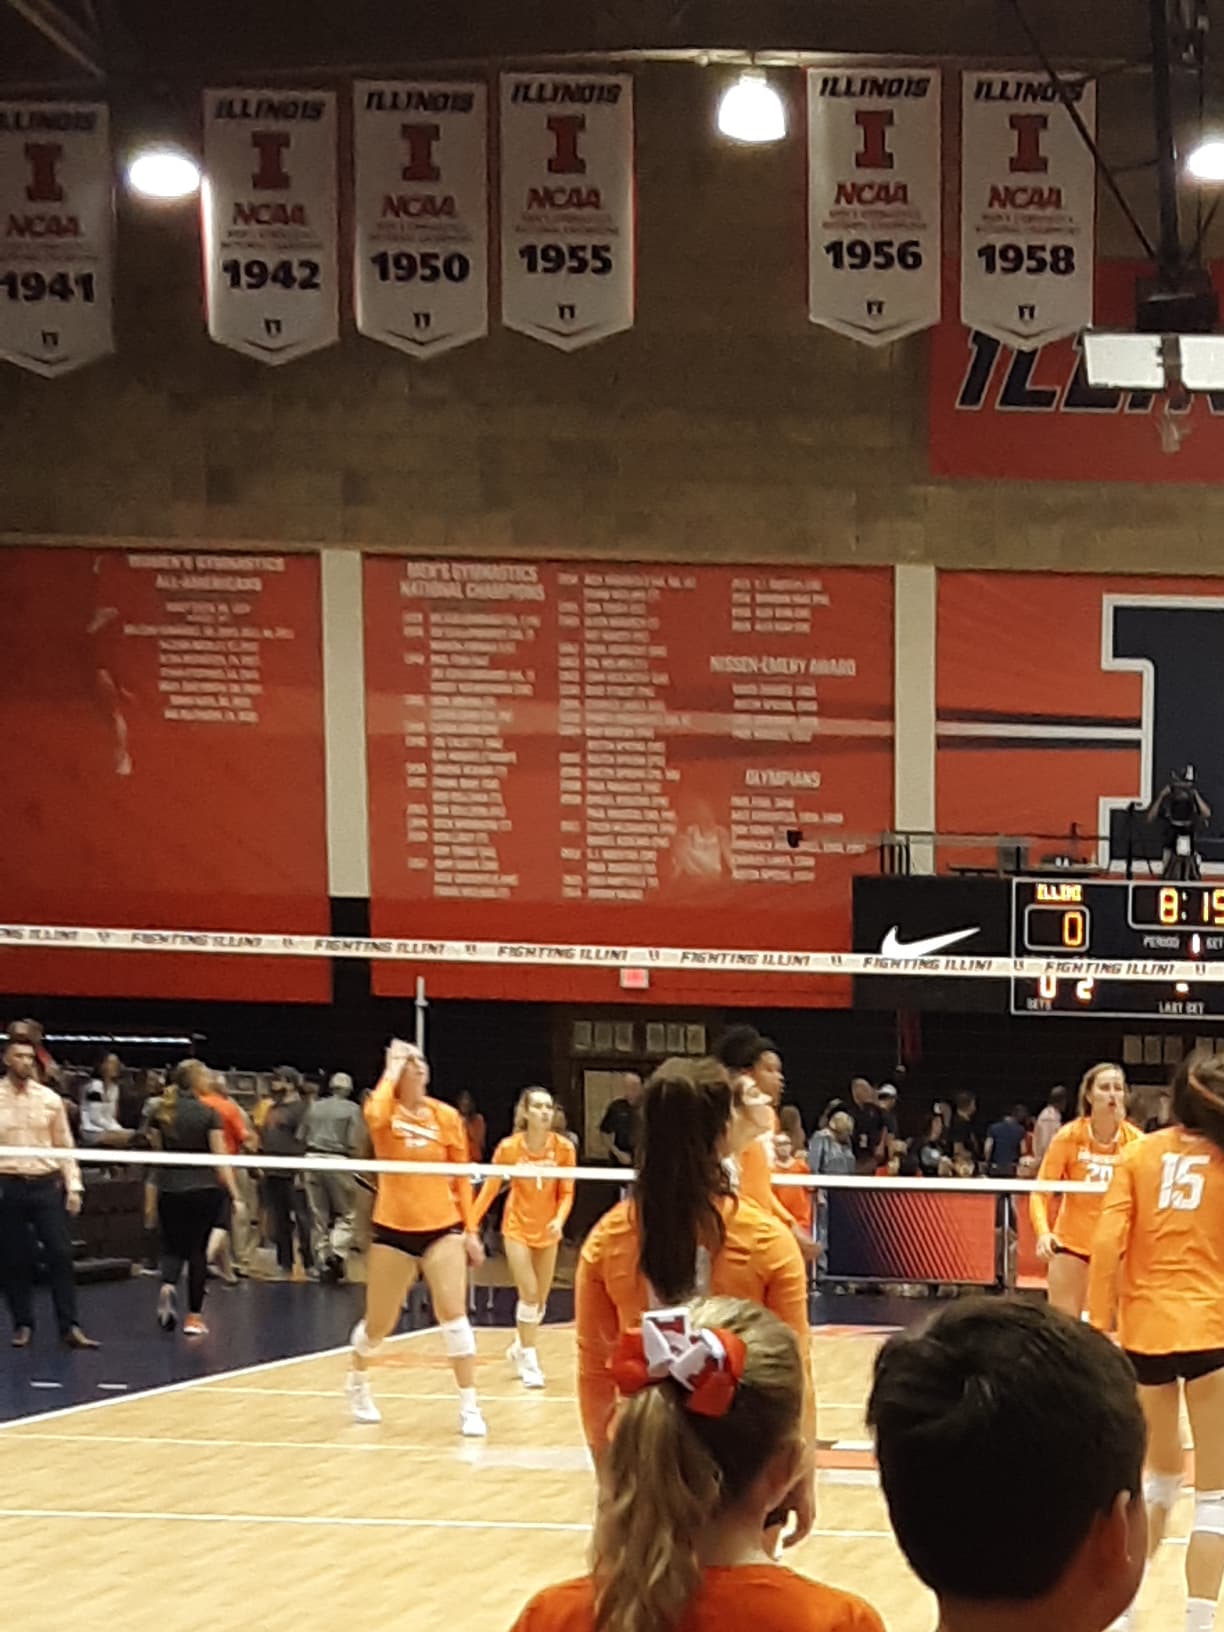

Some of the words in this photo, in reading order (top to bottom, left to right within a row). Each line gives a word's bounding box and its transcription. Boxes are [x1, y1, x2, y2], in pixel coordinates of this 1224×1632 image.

[511, 82, 622, 105] ILLINOIS
[819, 76, 931, 98] ILLINOIS
[214, 99, 325, 121] ILLINOIS
[366, 90, 475, 113] ILLINOIS
[0, 112, 96, 131] LLINOIS
[527, 186, 602, 210] NCAA
[834, 182, 909, 205] NCAA
[988, 185, 1062, 209] NCAA
[233, 204, 305, 226] NCAA
[382, 195, 455, 217] NCAA
[6, 215, 80, 237] NCAA
[519, 244, 613, 275] 1955
[823, 240, 923, 270] 1956
[977, 244, 1075, 275] 1958
[222, 259, 321, 290] 1942
[370, 252, 470, 283] 1950
[2, 271, 94, 302] 1941
[1063, 911, 1083, 945] 0
[497, 946, 575, 960] FIGHTING
[580, 948, 628, 961] ILLINI
[680, 951, 757, 965] FIGHTING
[762, 954, 810, 967] ILLINI
[862, 957, 940, 970] FIGHTING
[944, 960, 993, 971] ILLINI
[1044, 961, 1122, 975] FIGHTING
[1126, 964, 1175, 976] ILLINI
[1158, 1151, 1210, 1211] 15
